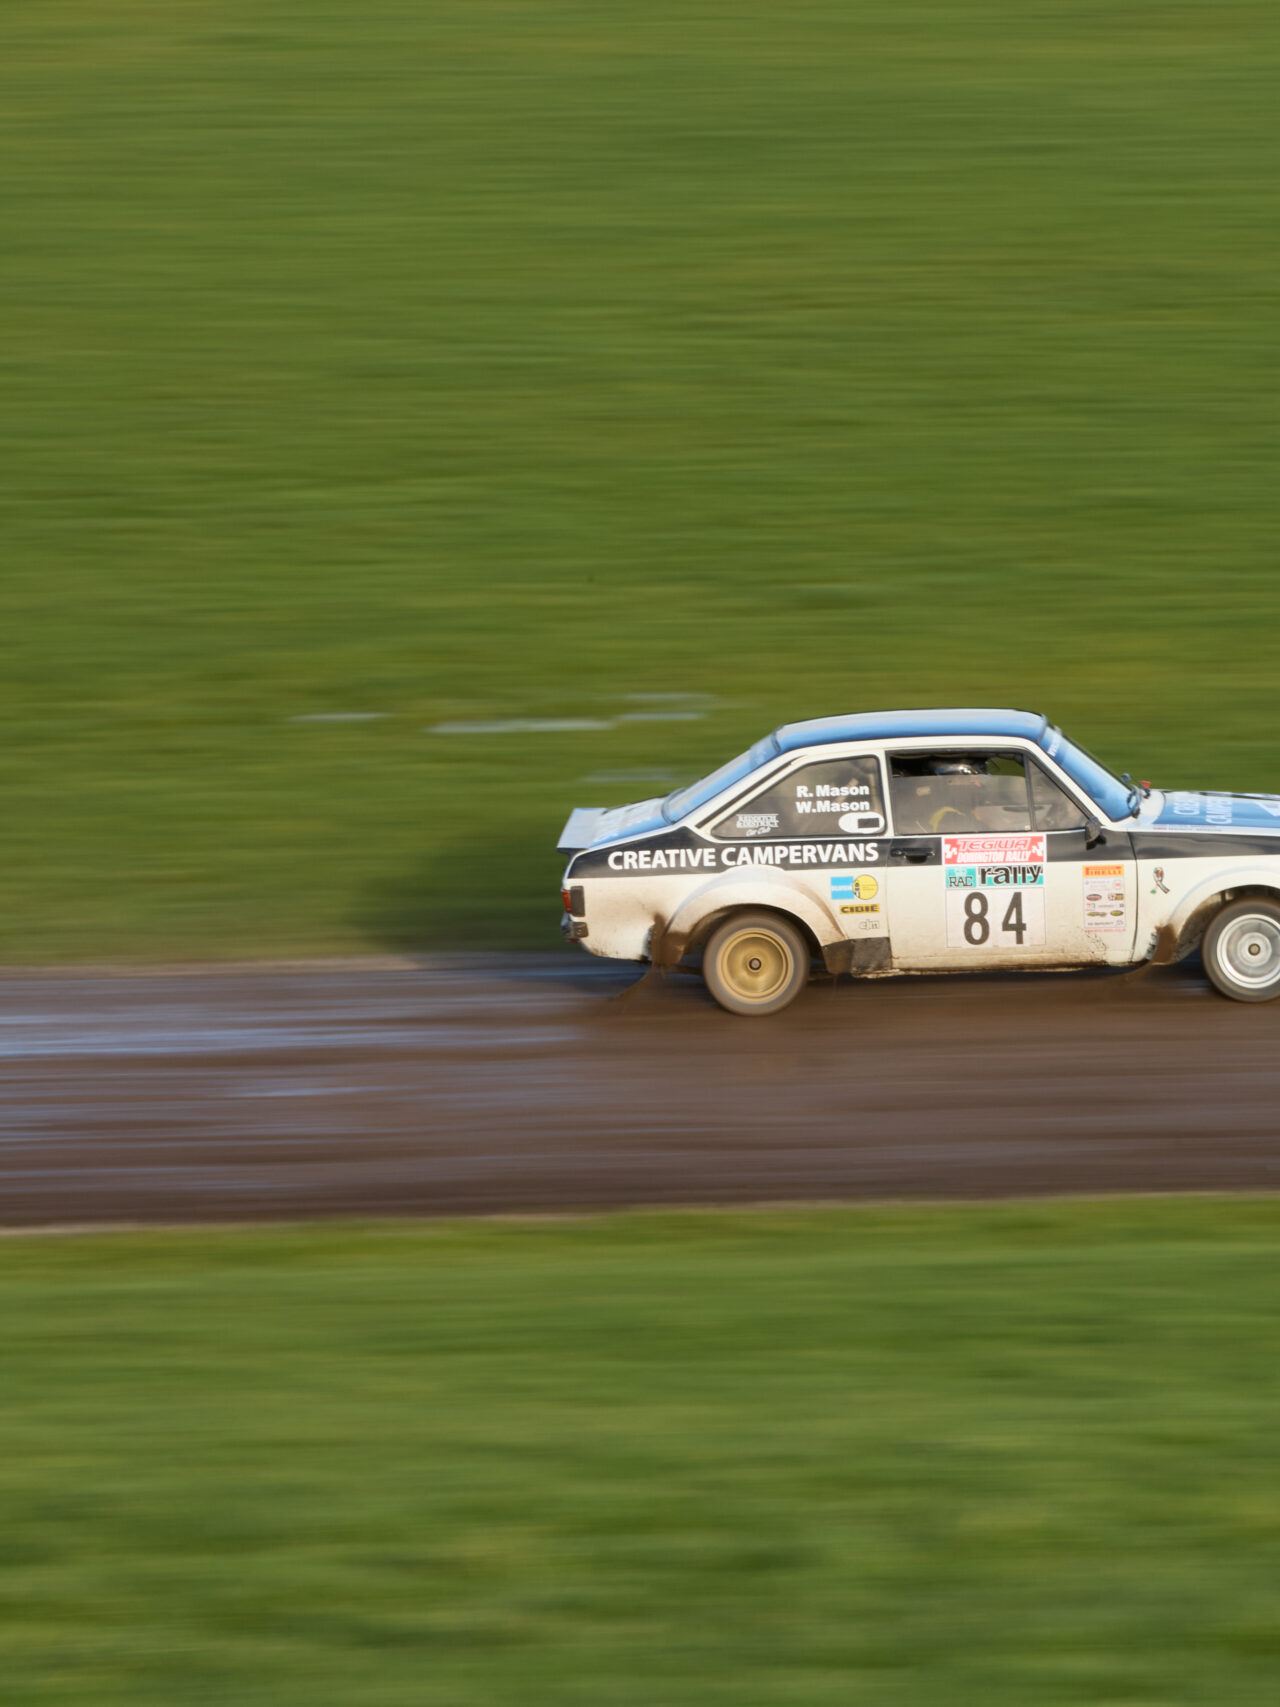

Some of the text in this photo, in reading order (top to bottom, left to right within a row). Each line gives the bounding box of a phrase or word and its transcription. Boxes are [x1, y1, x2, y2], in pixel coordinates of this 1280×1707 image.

[796, 784, 870, 798] R. Mason
[957, 837, 1031, 852] TEGIWA
[607, 843, 879, 871] CREATIVE CAMPERVANS
[1004, 850, 1031, 862] RALLY
[949, 876, 973, 887] RAC
[980, 865, 1041, 885] rally
[963, 891, 1027, 945] 84
